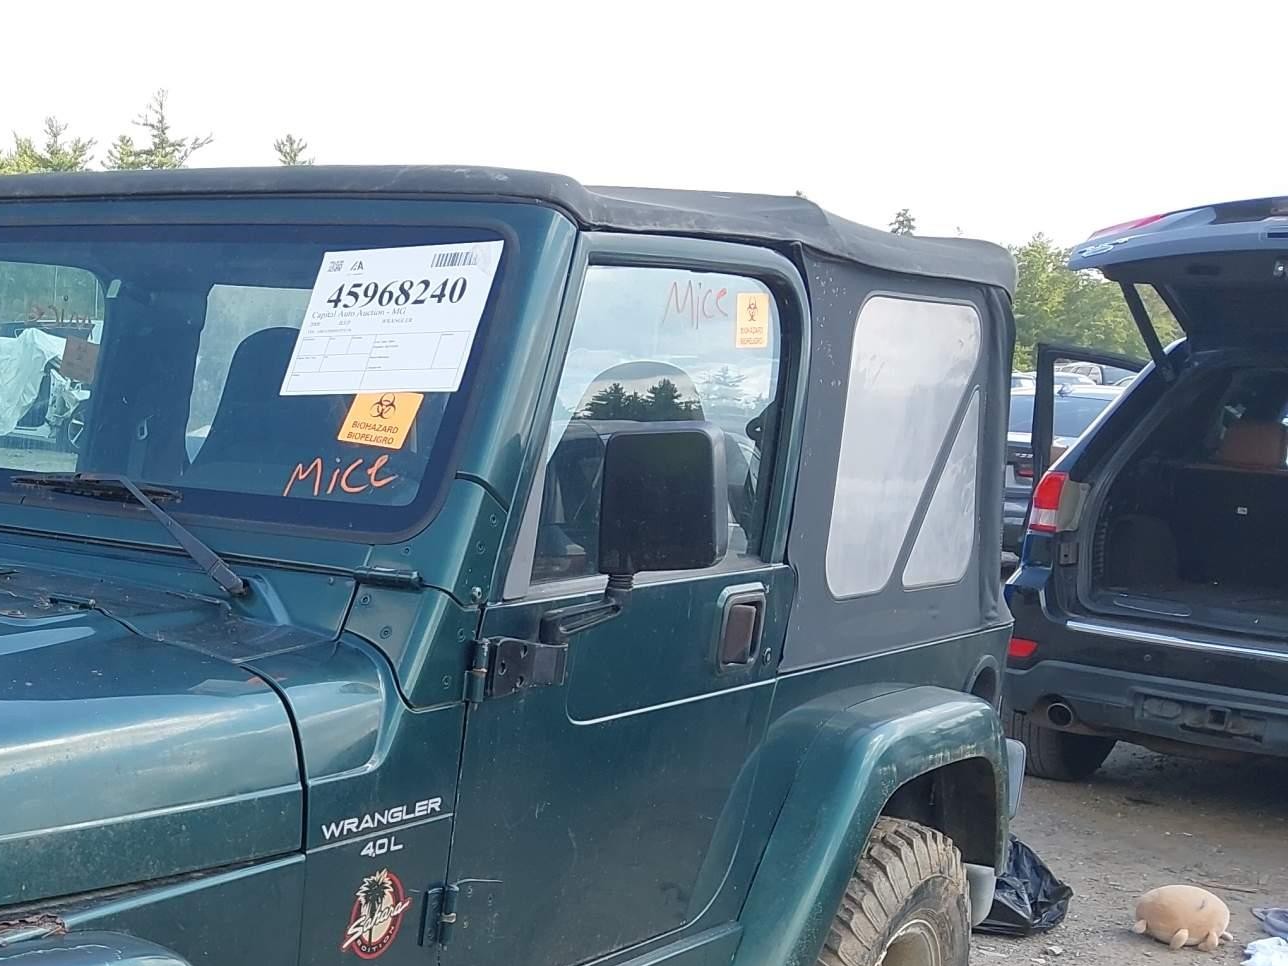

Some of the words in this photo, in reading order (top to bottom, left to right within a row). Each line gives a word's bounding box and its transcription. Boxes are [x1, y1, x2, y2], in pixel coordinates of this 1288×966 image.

[326, 276, 468, 309] 45968240
[662, 280, 729, 330] Mice
[311, 310, 337, 321] Capital
[338, 309, 356, 318] Auto
[357, 308, 385, 317] Auction
[346, 431, 394, 445] BIOPELIGRO
[351, 420, 399, 435] BIOHAZARD
[283, 454, 399, 497] Mice
[321, 796, 442, 840] WRANGLER
[341, 900, 411, 949] Sahara
[355, 925, 395, 953] EDITION
